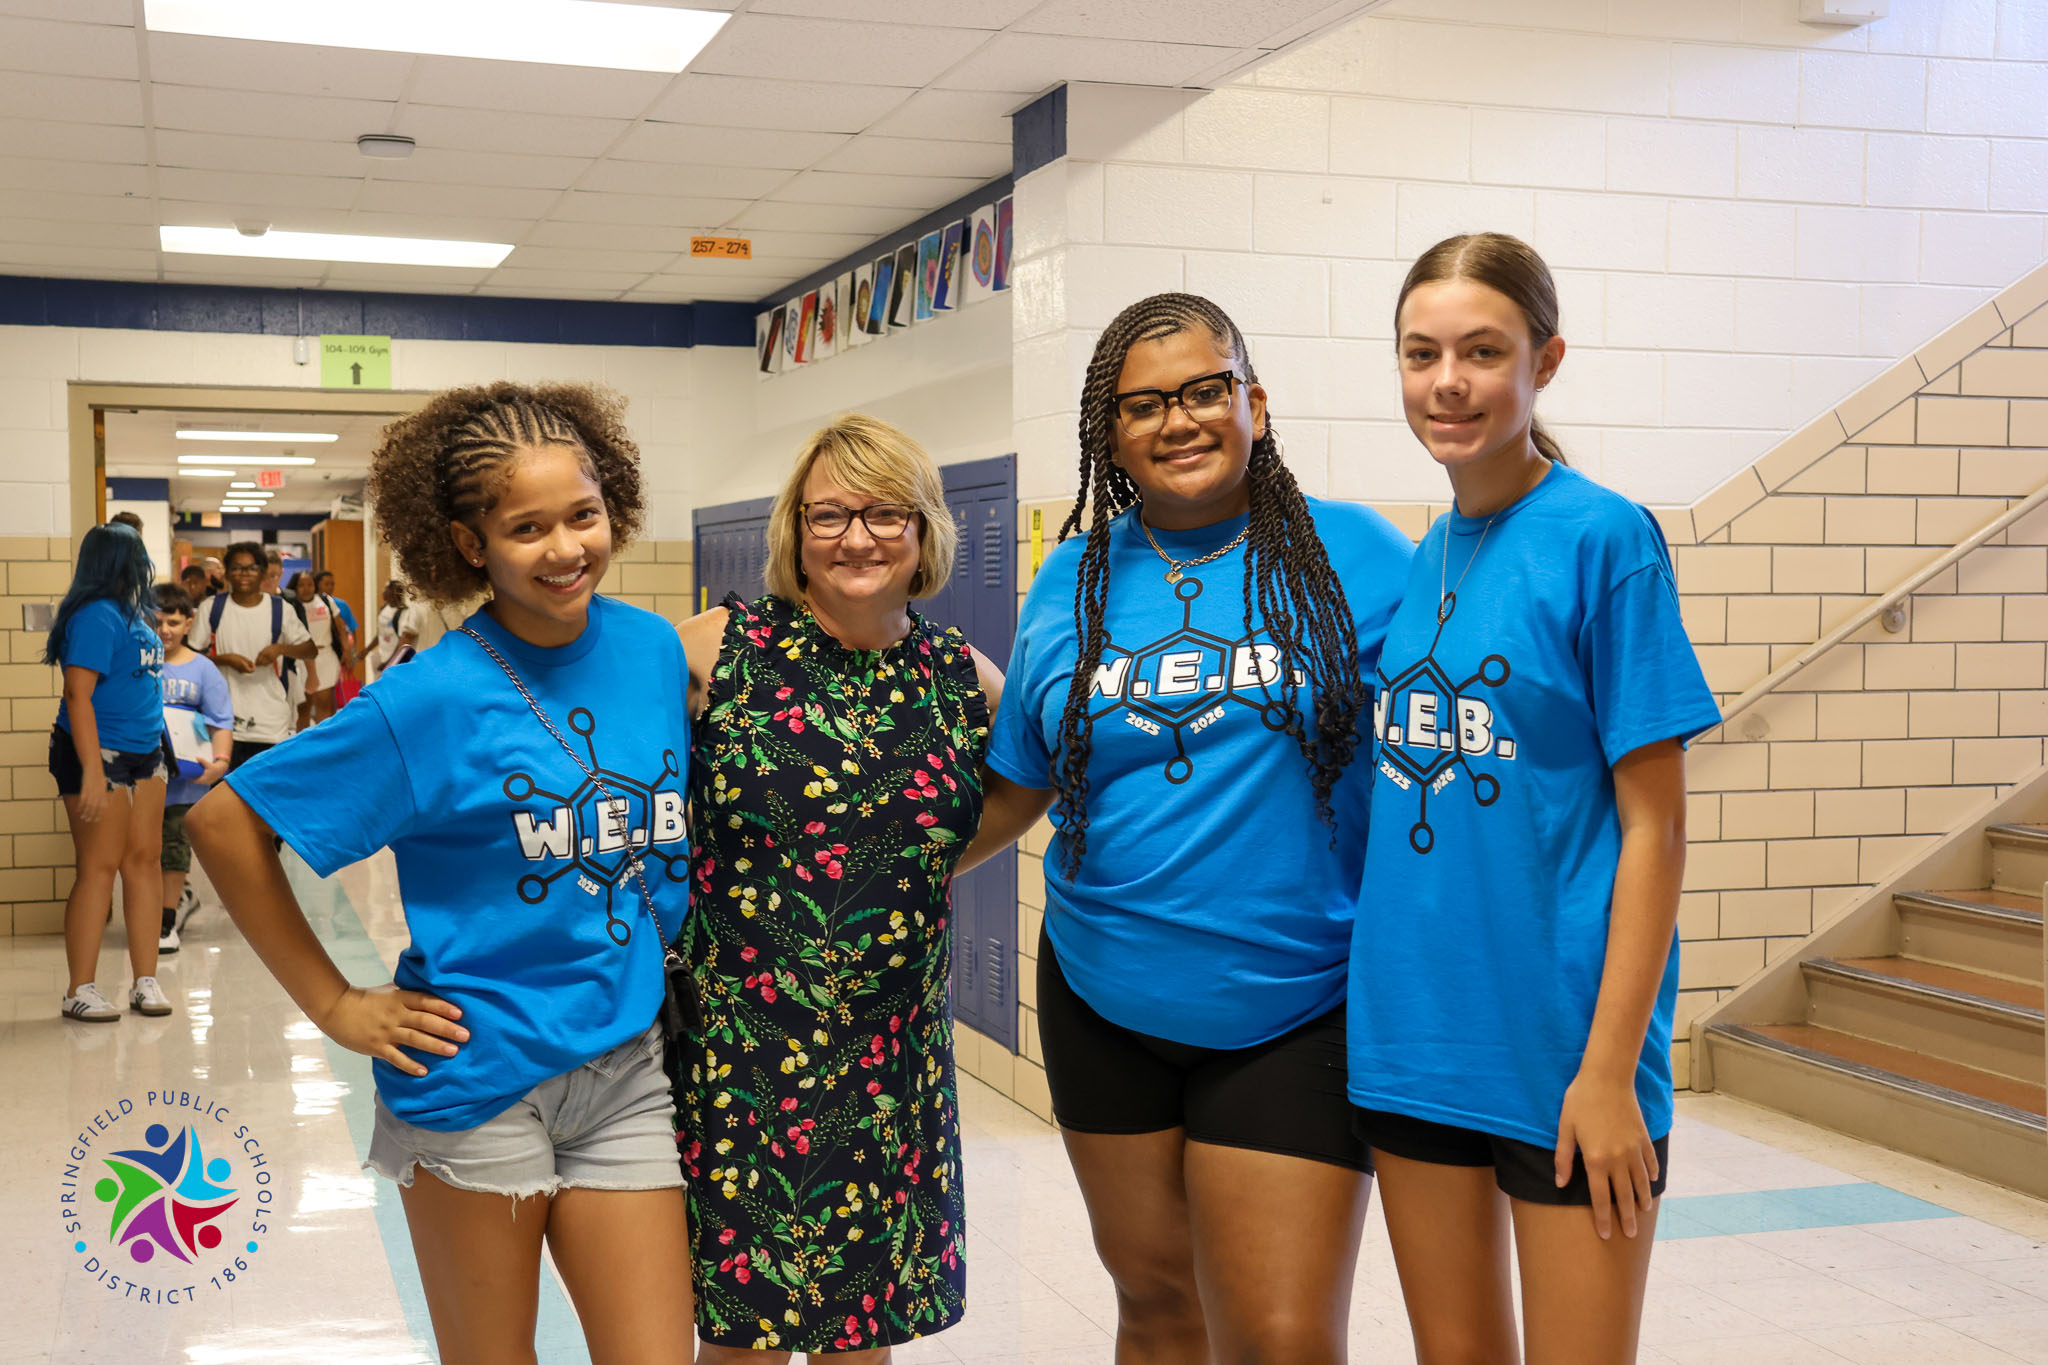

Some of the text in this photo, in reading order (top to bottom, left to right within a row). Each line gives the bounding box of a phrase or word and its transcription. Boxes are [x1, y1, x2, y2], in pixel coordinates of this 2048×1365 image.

[692, 240, 715, 253] 257
[726, 241, 748, 255] 274
[368, 345, 388, 357] Gym
[1125, 705, 1226, 736] 2025 2026
[1379, 760, 1412, 790] 2025
[577, 874, 600, 896] 2025
